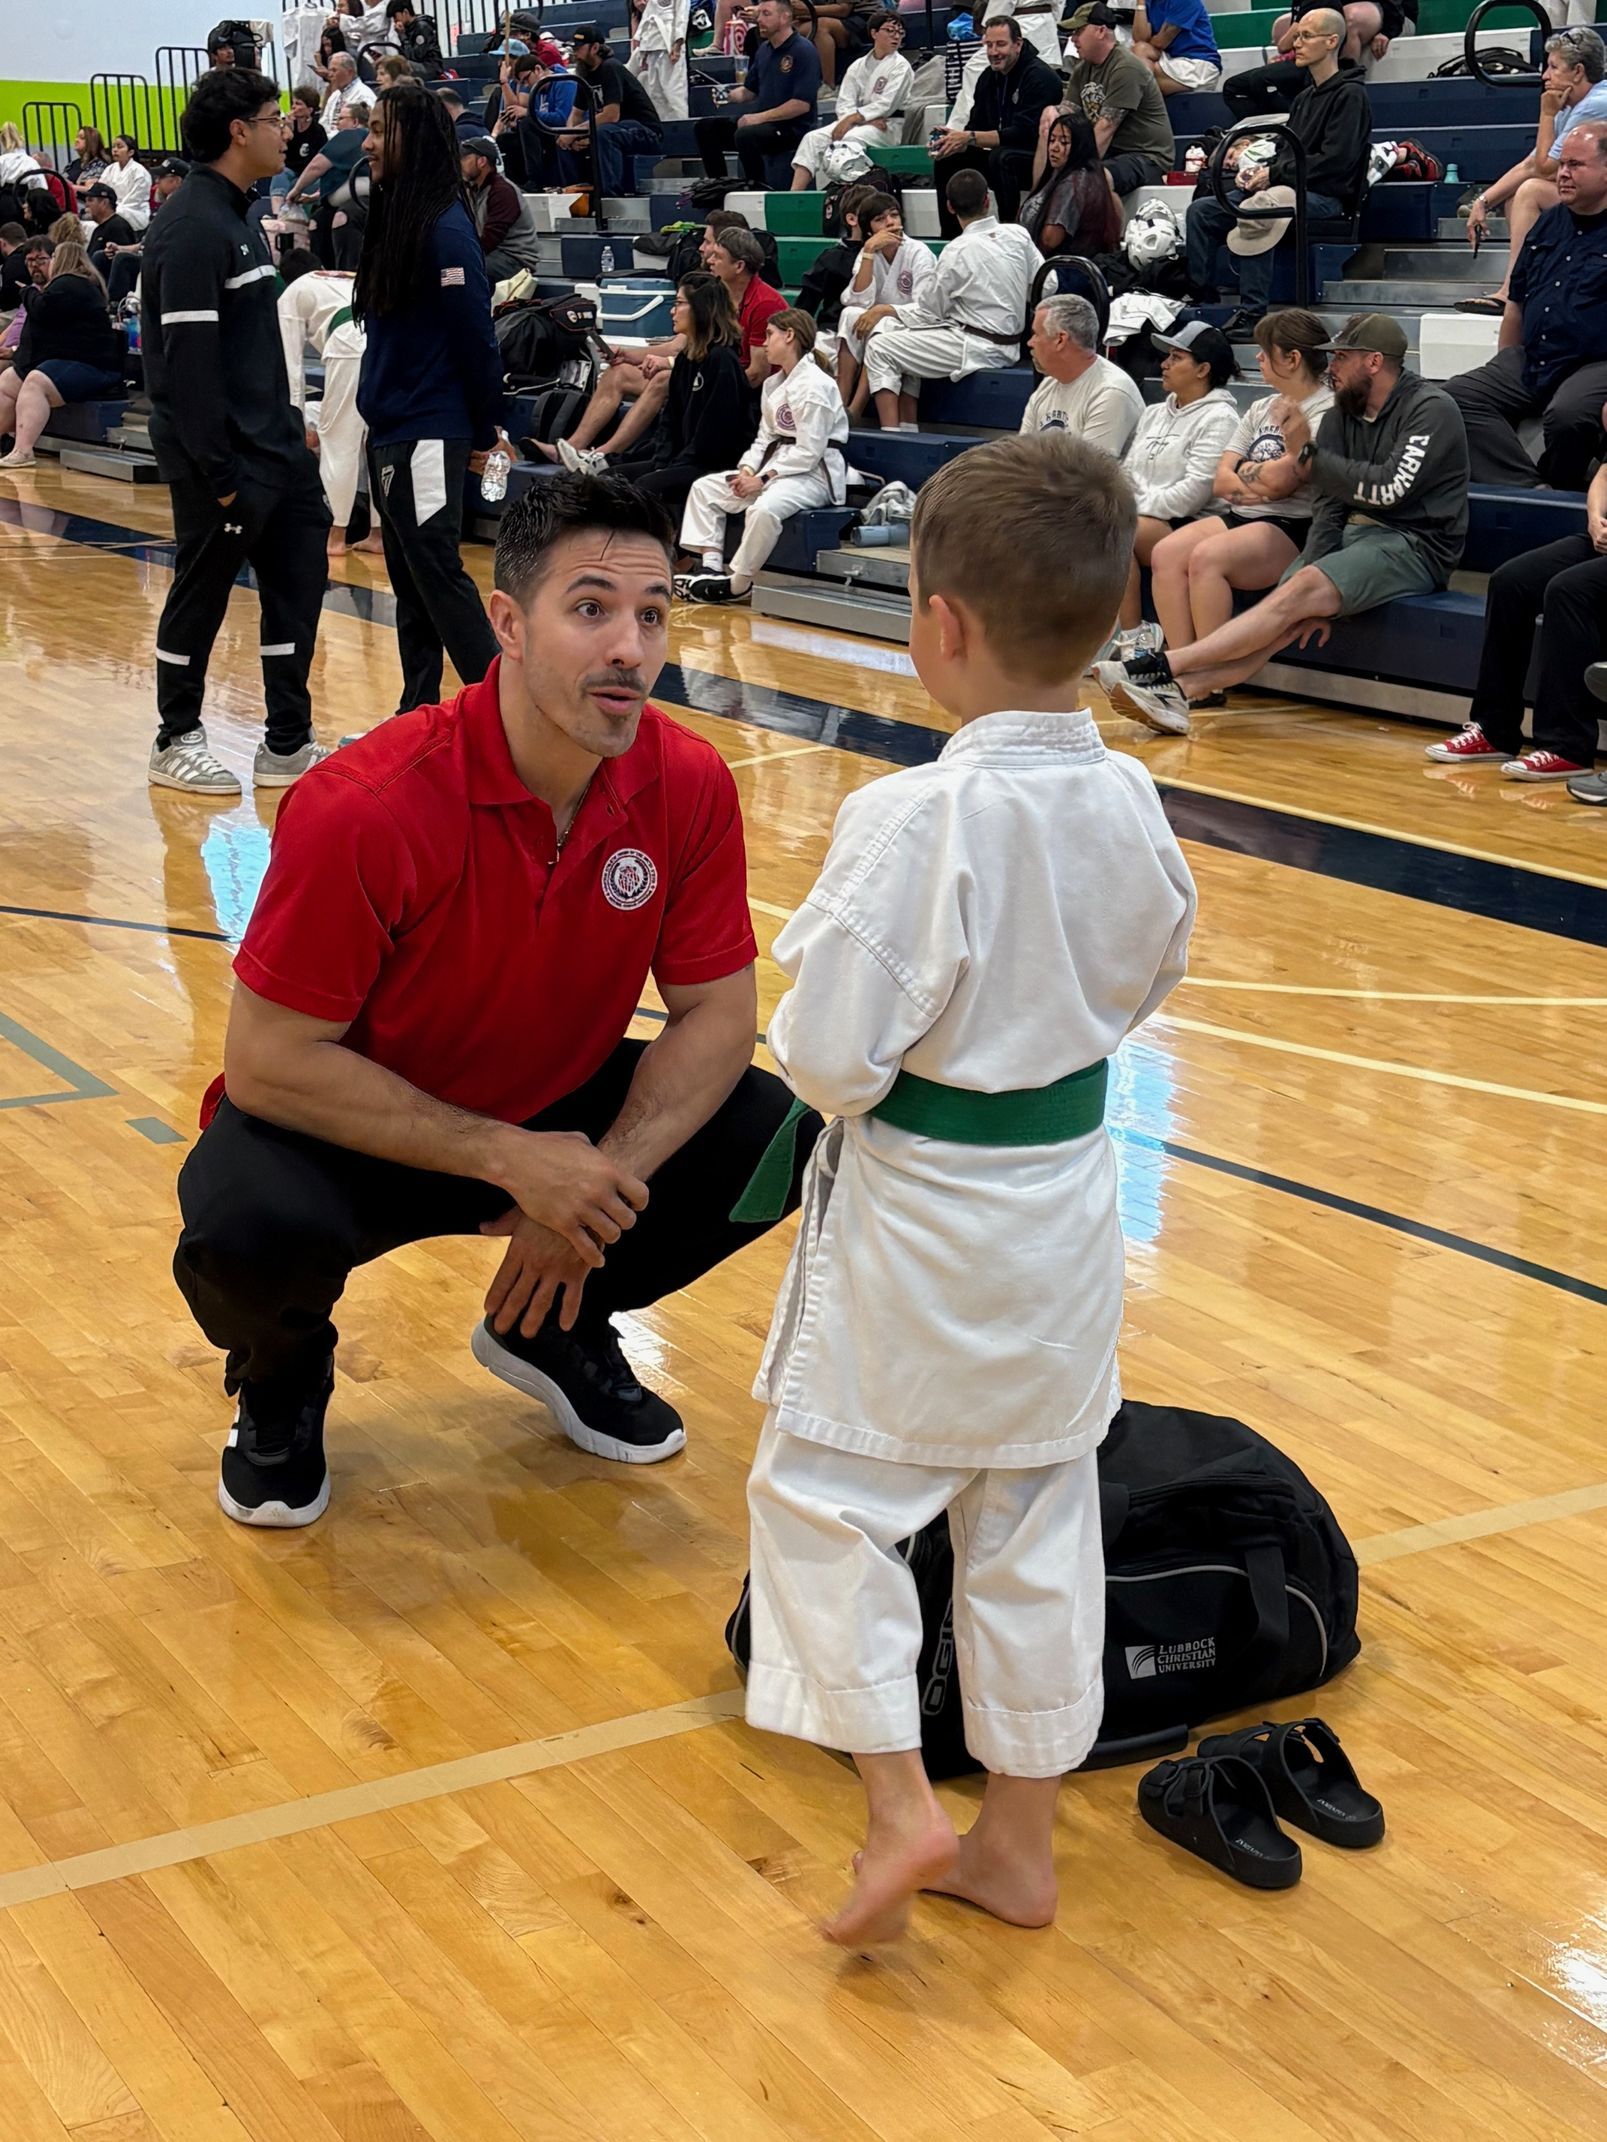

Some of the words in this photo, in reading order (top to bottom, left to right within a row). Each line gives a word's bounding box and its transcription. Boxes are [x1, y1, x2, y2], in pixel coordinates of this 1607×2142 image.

[1158, 1636, 1215, 1654] LUBBOCK
[1157, 1647, 1216, 1664] CHRISTIAN
[1158, 1658, 1216, 1674] UNIVERSITY
